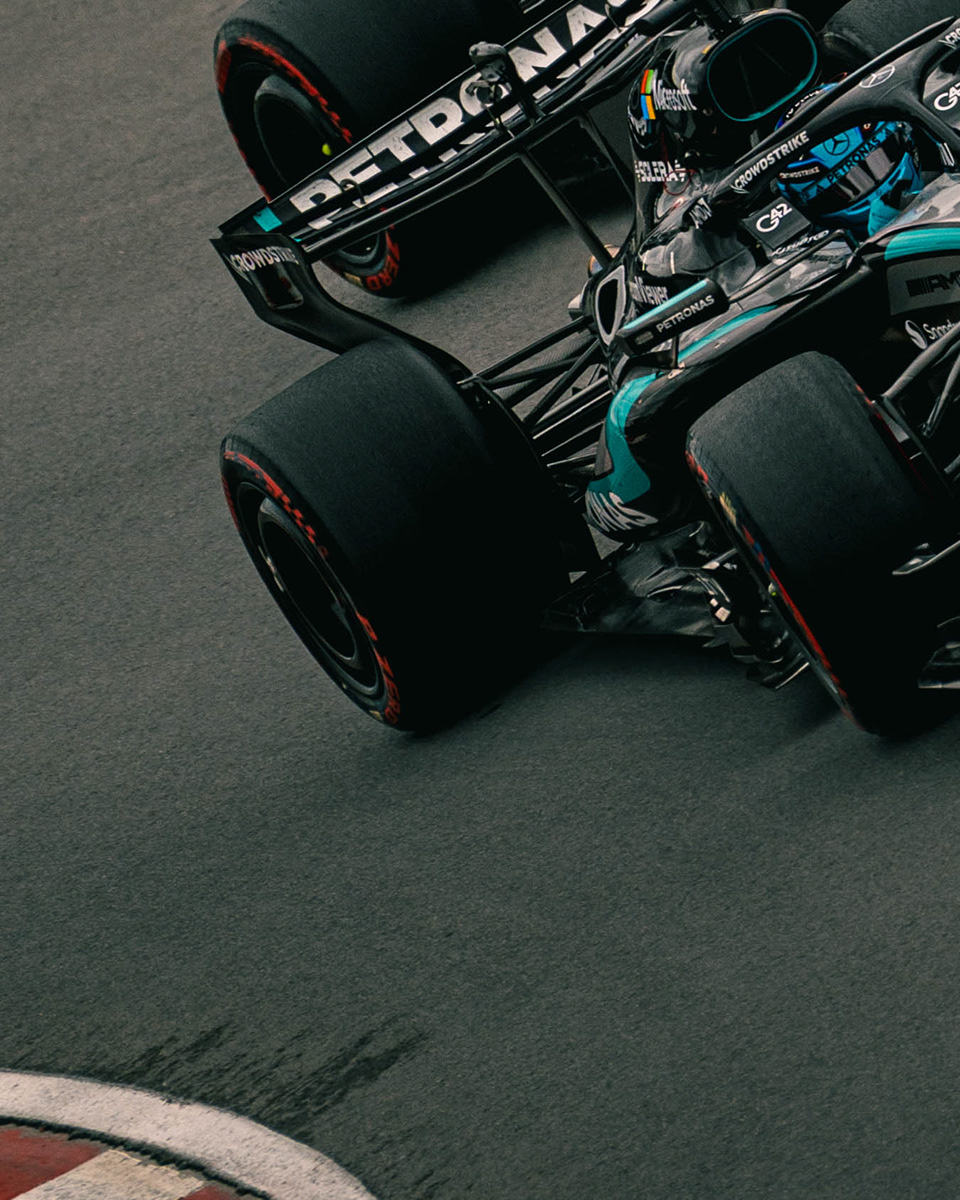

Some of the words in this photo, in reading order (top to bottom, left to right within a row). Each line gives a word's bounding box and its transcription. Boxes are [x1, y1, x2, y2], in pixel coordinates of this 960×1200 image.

[734, 130, 810, 191] CROWDSTRIKE
[827, 136, 882, 184] PETRONAS
[756, 203, 793, 233] G42
[655, 295, 716, 333] PETRONAS
